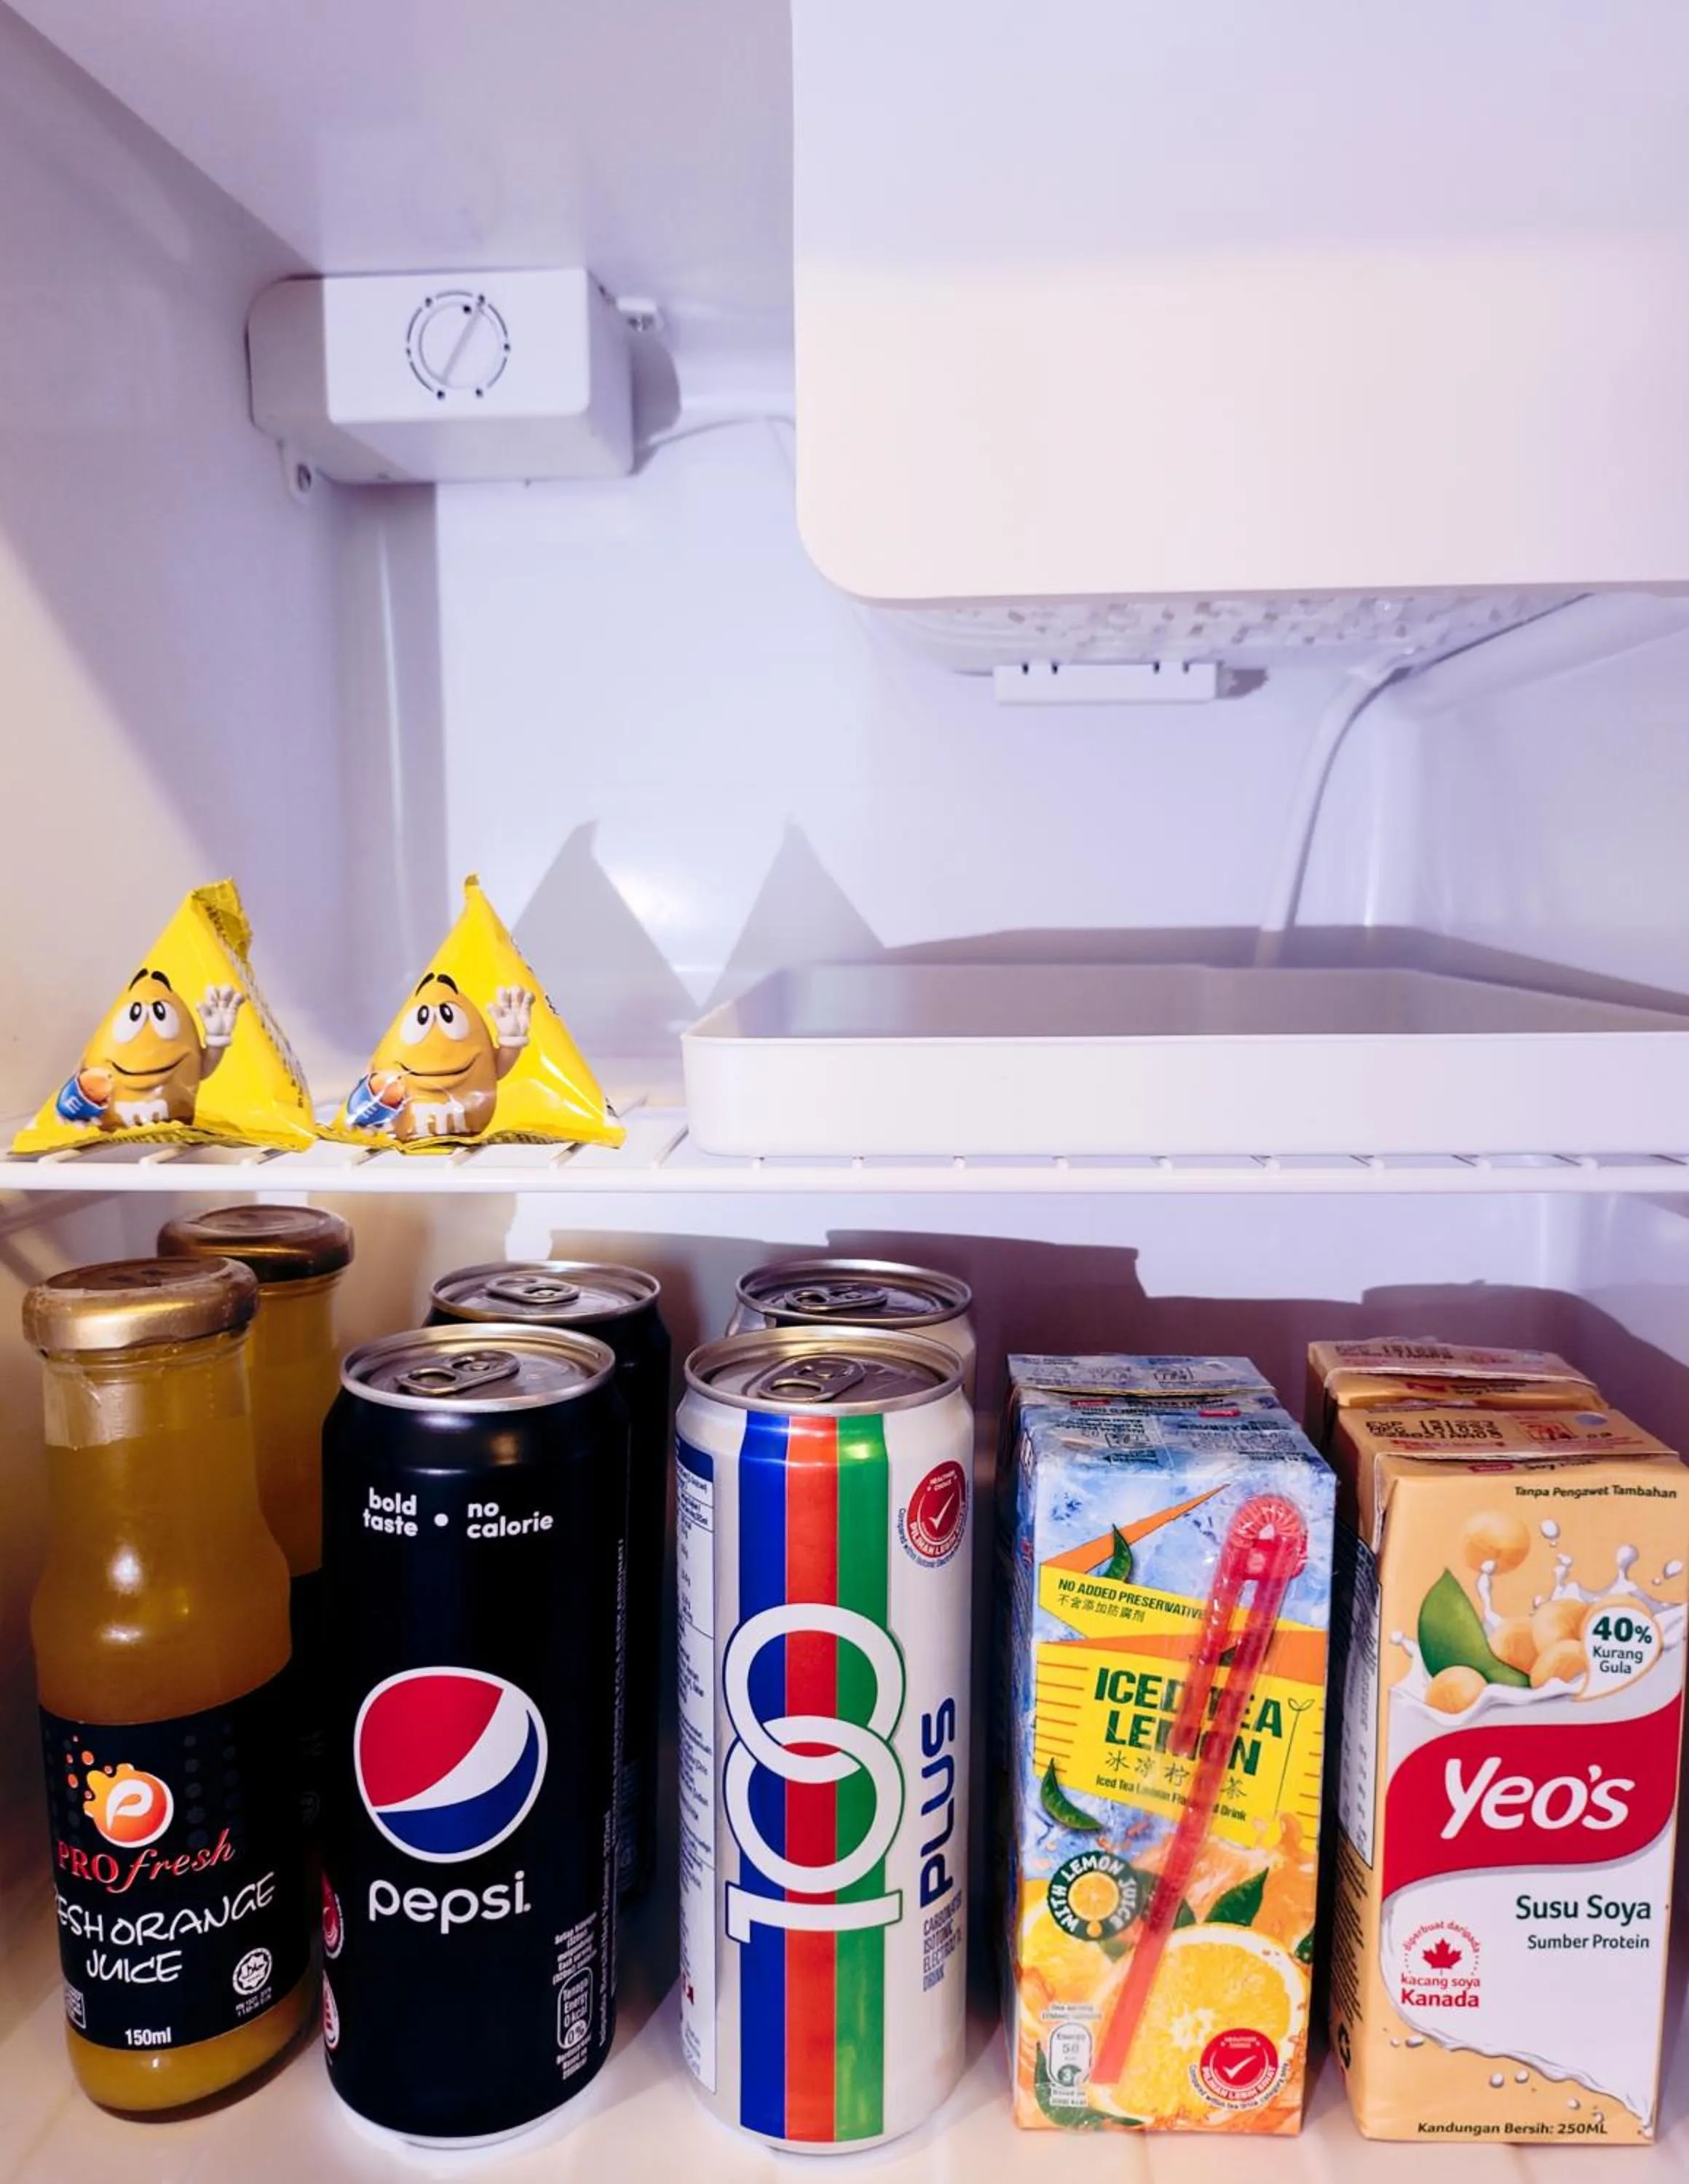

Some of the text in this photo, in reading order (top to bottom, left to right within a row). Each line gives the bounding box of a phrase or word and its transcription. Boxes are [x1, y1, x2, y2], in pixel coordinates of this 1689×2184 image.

[368, 1487, 417, 1516] bold
[1514, 1485, 1677, 1499] Tanpa Pengawet Tambahan
[363, 1509, 419, 1538] taste
[467, 1502, 500, 1519] no
[466, 1511, 554, 1539] calorie
[1059, 1578, 1075, 1592] NO
[1077, 1583, 1117, 1601] ADDED
[1591, 1616, 1653, 1645] 40%
[1592, 1646, 1643, 1664] Kurang
[1599, 1661, 1632, 1675] Gula
[724, 1602, 906, 1945] 100
[919, 1697, 956, 1909] PLUS
[1096, 1774, 1117, 1789] Iced
[1119, 1779, 1135, 1793] Tea
[1219, 1803, 1246, 1821] Drink
[1440, 1756, 1636, 1840] Yeo's
[1050, 1855, 1137, 1933] WITH LEMON JUICE
[56, 1872, 276, 1947] ESH ORANGE
[1516, 1894, 1651, 1926] Susu Soya
[1527, 1934, 1650, 1950] Sumber Protein
[85, 1949, 183, 1984] JUICE
[1401, 1972, 1480, 1990] kacang soya
[1401, 1987, 1480, 2008] Kanada
[124, 2026, 172, 2046] 150ml
[1417, 2122, 1608, 2136] Kandungan Bersih: 250ML
